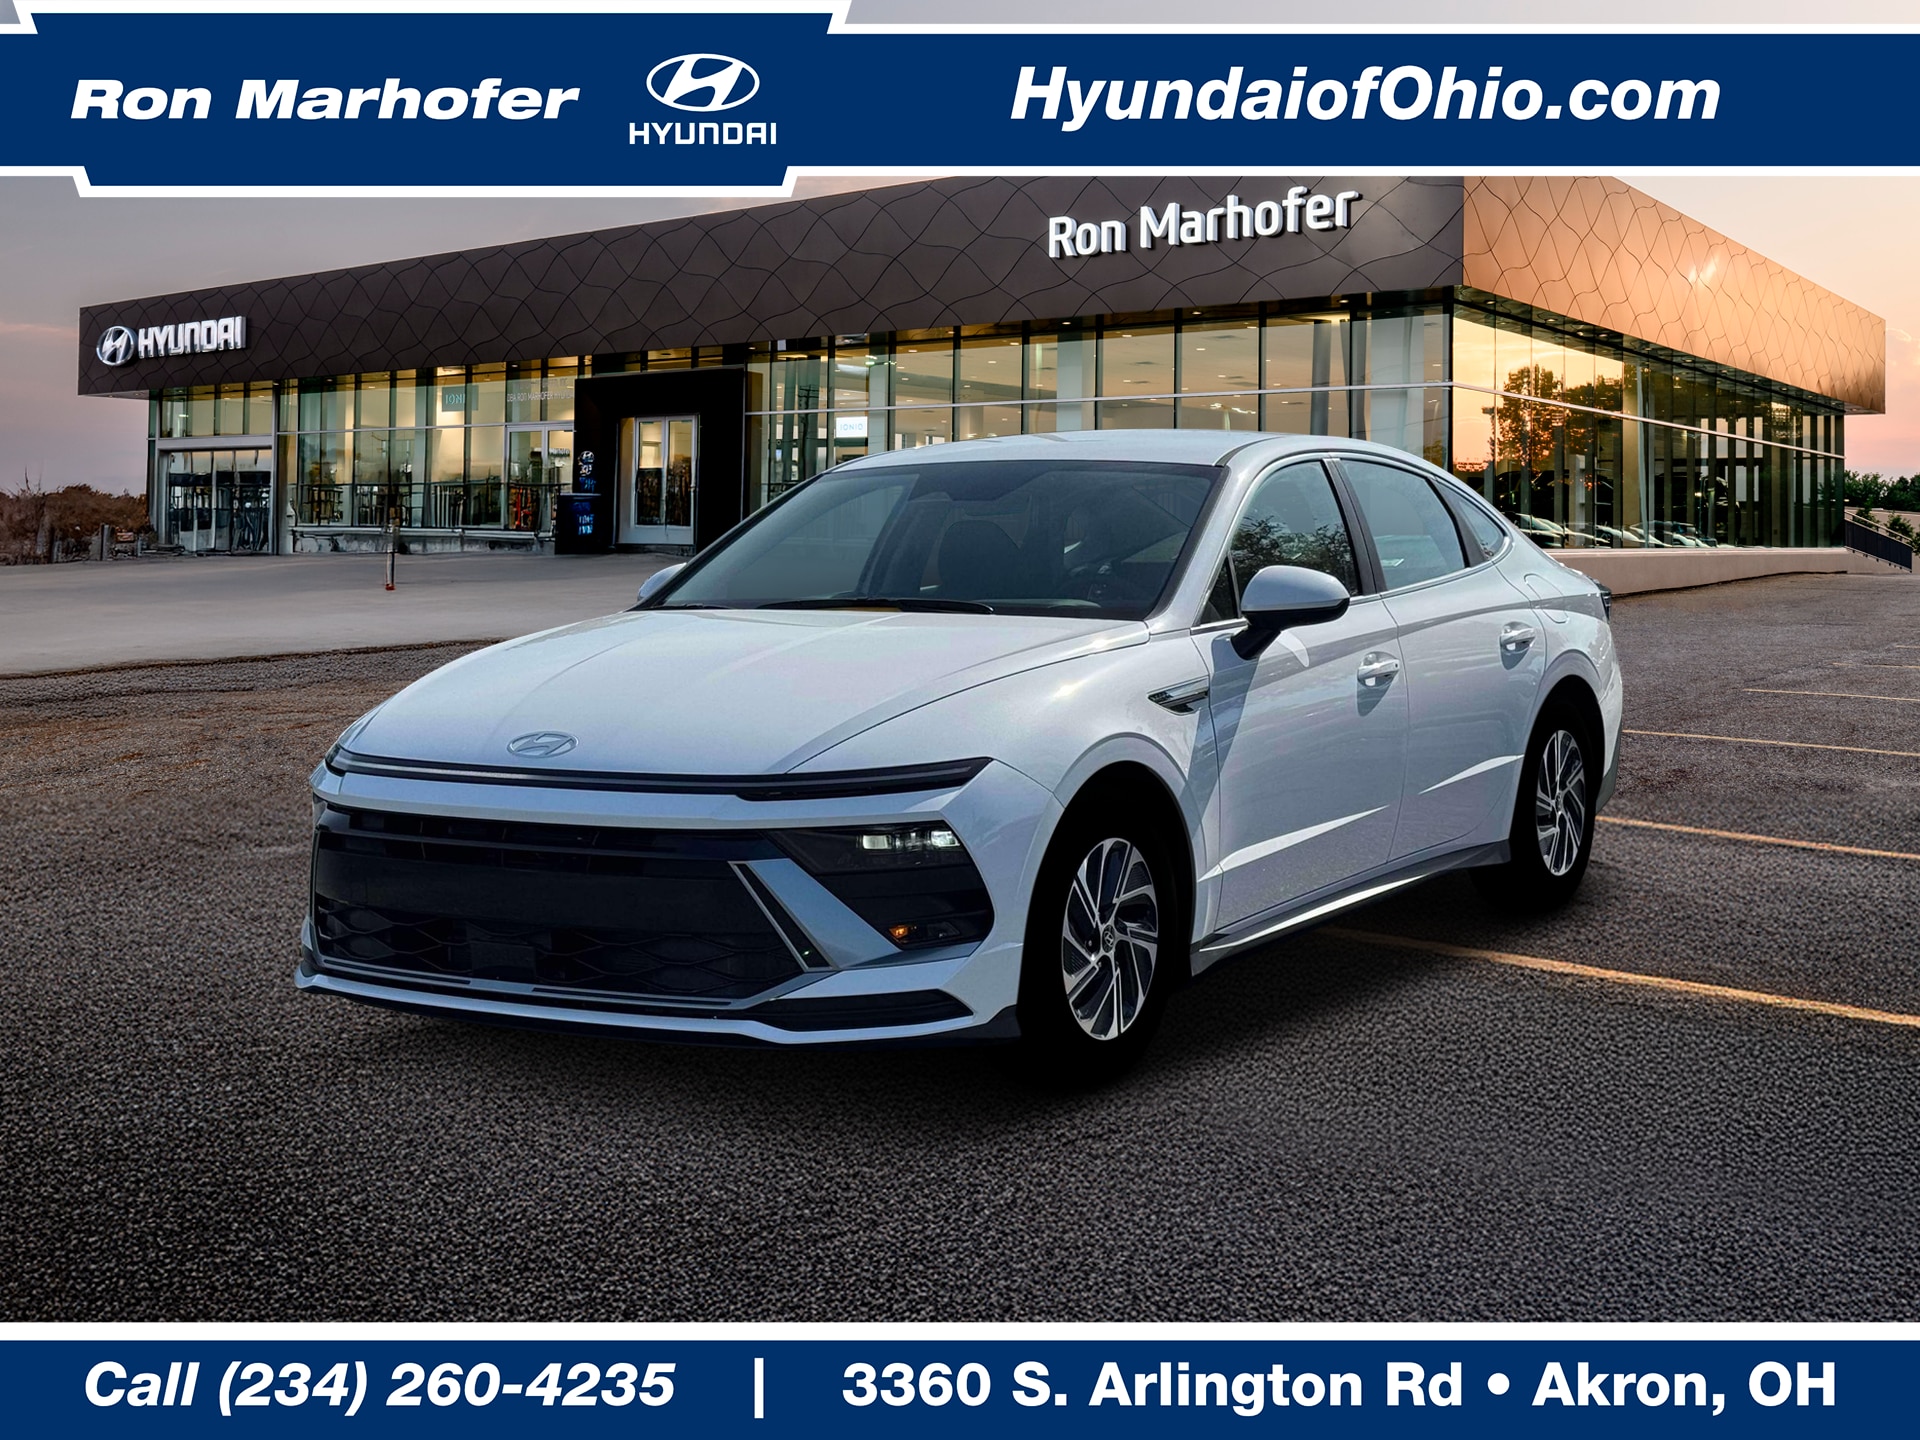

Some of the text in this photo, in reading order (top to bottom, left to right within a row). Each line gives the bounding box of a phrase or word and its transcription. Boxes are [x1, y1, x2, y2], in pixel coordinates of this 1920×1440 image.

[1048, 186, 1360, 258] Ron Marhofer
[138, 316, 247, 358] HYUNDAI
